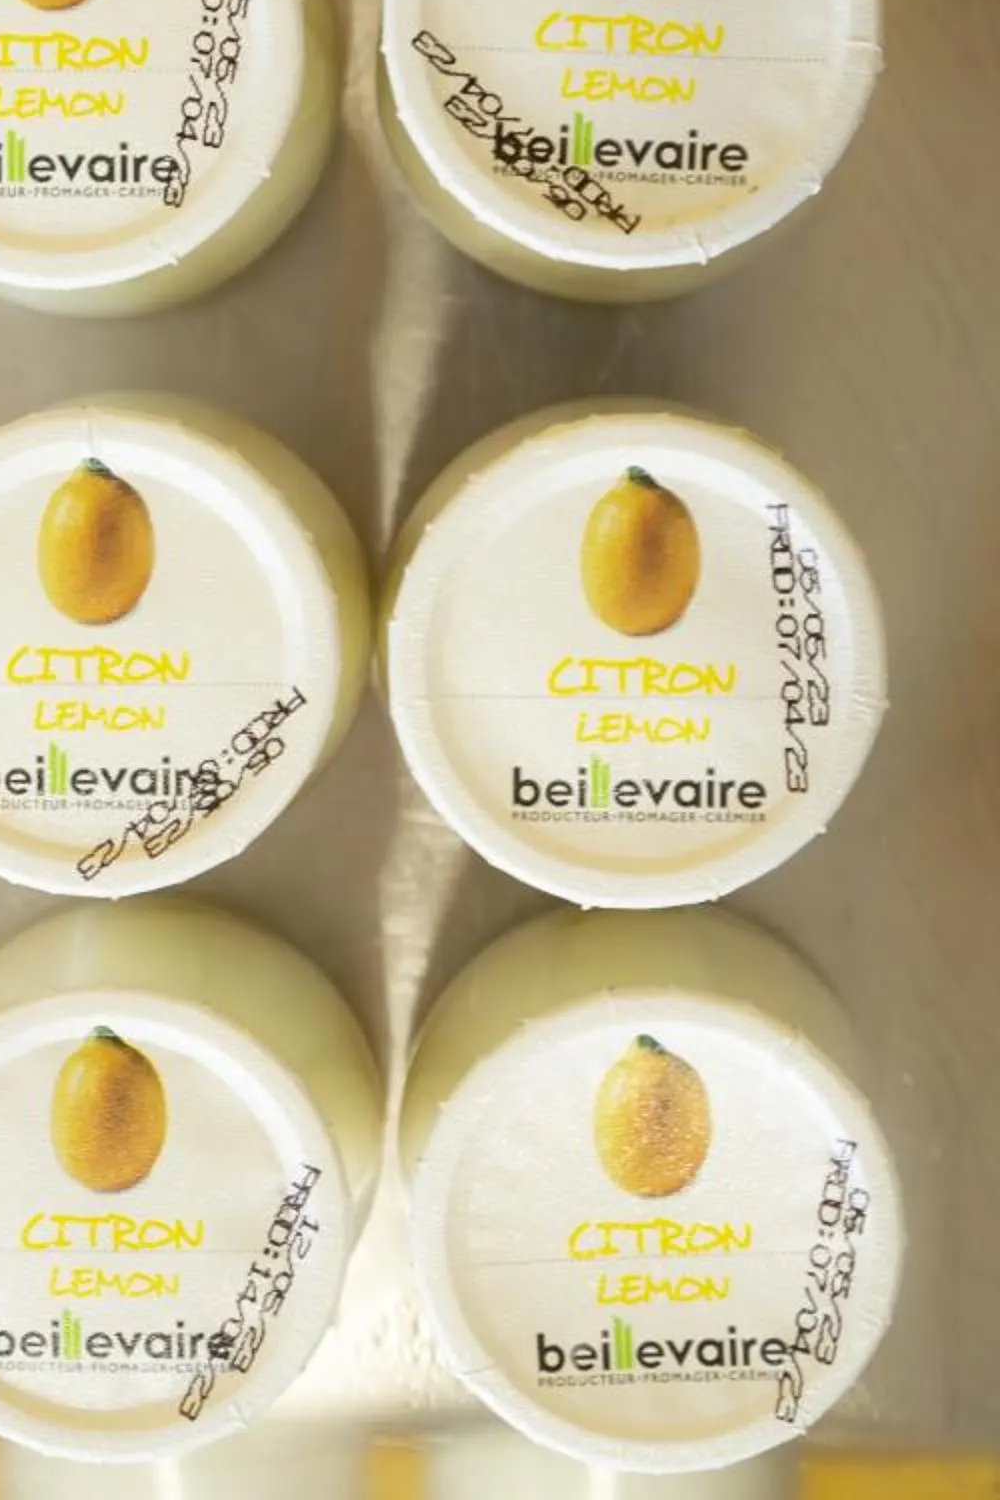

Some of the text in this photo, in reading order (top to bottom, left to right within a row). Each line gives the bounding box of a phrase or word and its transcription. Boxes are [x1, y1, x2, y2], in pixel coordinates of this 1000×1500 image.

[535, 12, 724, 55] CITRON
[562, 69, 695, 102] LEMON
[6, 646, 189, 684] CITRON
[548, 656, 736, 696] CITRON
[35, 702, 164, 731] LEMON
[577, 713, 710, 743] LEMON
[513, 754, 767, 808] beillevaire
[23, 1214, 204, 1250] CITRON
[568, 1218, 752, 1259] CITRON
[51, 1268, 178, 1297] LEMON
[232, 1216, 320, 1373] 12/05/23
[598, 1274, 729, 1305] LEMON
[537, 1315, 788, 1372] beillevaire
